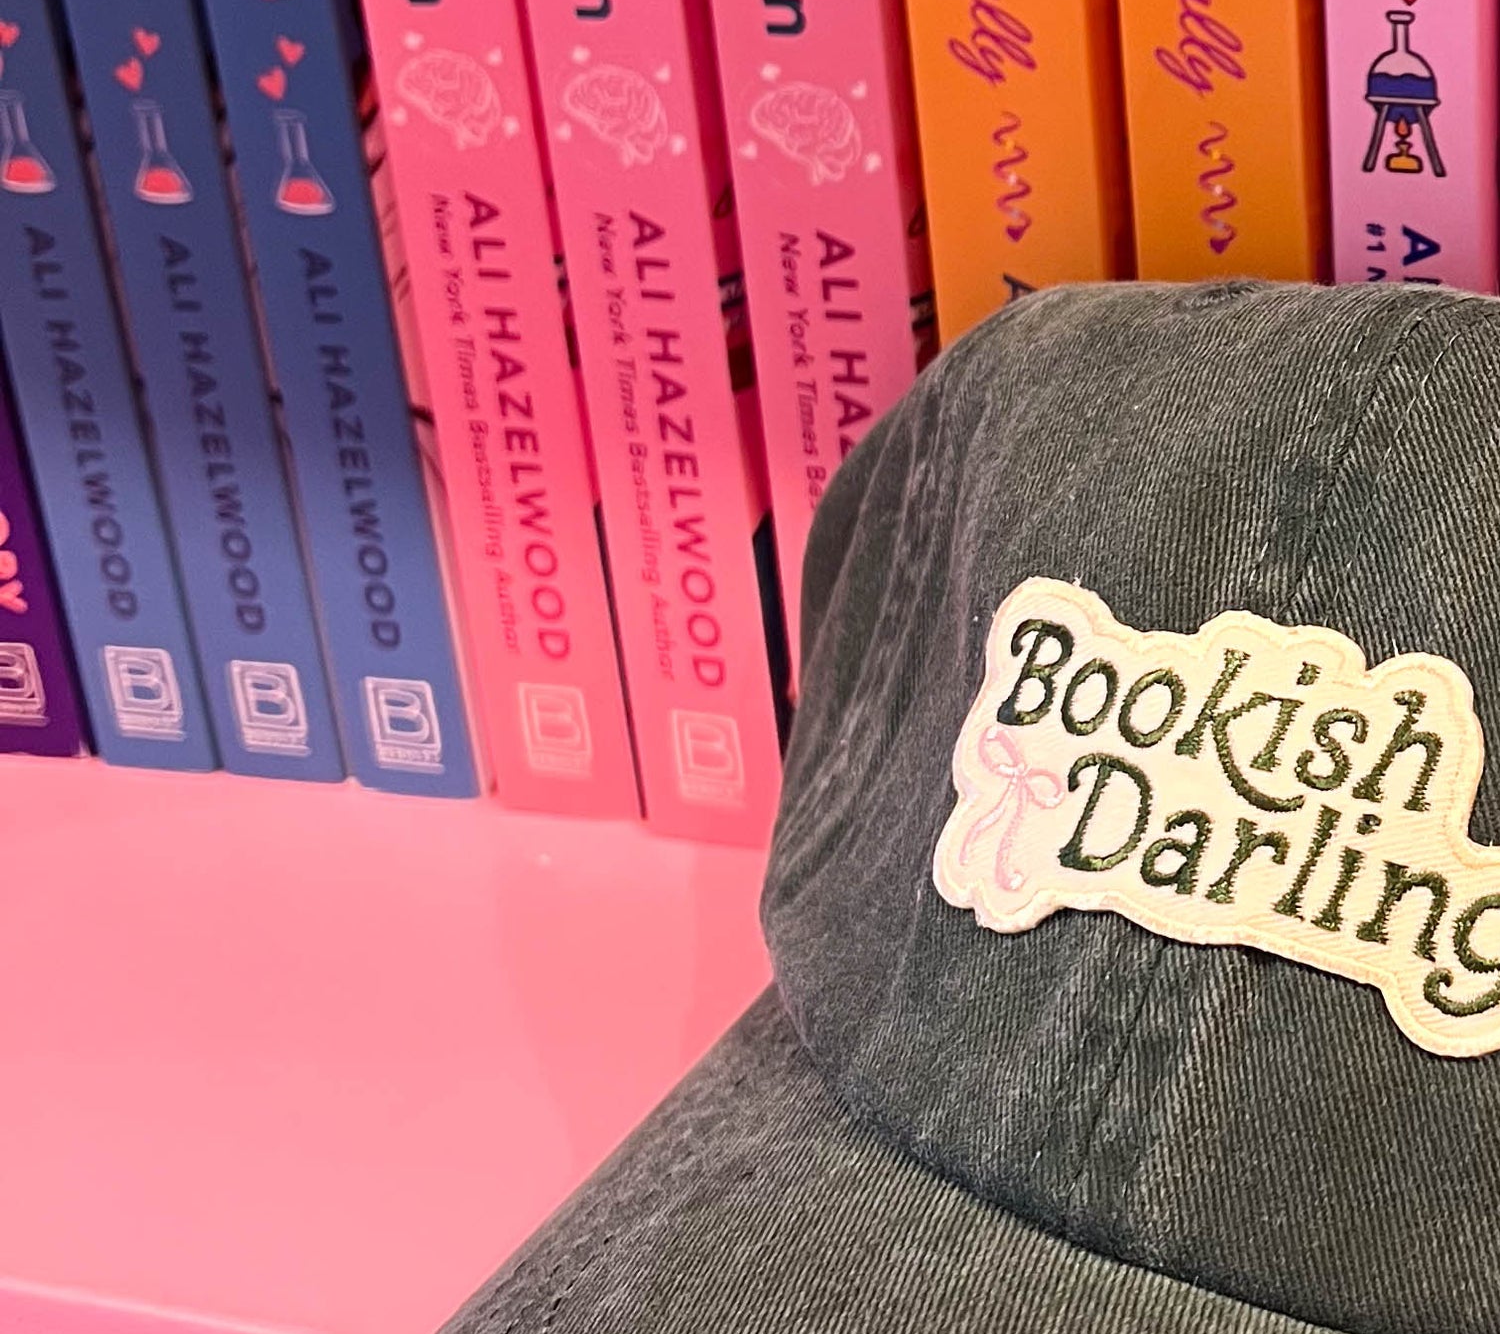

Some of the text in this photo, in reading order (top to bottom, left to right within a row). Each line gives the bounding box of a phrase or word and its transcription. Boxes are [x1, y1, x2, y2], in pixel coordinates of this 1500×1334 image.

[778, 231, 803, 298] New
[815, 228, 865, 323] ALI
[1366, 223, 1386, 253] #1
[443, 268, 468, 326] York
[787, 307, 817, 369] York
[453, 333, 479, 413] Times
[796, 378, 819, 457] Times
[22, 223, 139, 621] ALI HAZELWOOD
[158, 234, 266, 636] ALI HAZELWOOD
[300, 246, 402, 651] ALI HAZELWOOD
[463, 189, 572, 663] ALI HAZELWOOD
[593, 211, 676, 684] New York Times Bestselling Author
[628, 209, 728, 691] ALI HAZELWOOD
[378, 691, 431, 743] B
[997, 617, 1446, 814] Bookish
